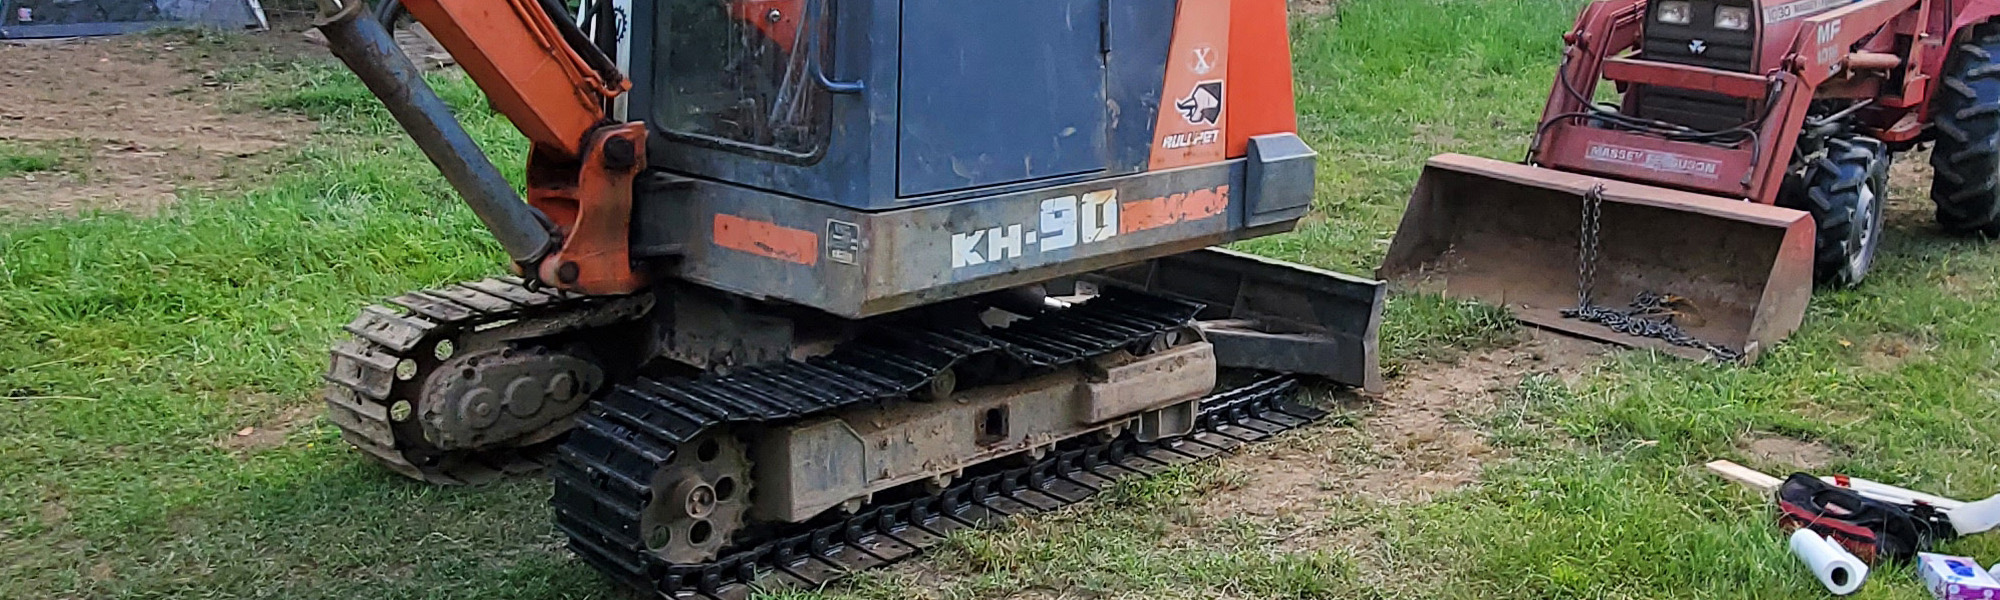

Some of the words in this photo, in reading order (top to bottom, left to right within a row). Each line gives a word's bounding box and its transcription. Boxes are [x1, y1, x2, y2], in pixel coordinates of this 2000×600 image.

[1768, 5, 1791, 21] 1030
[1817, 20, 1842, 45] MF
[1590, 145, 1644, 163] MASSEY
[951, 188, 1119, 268] KH-90
